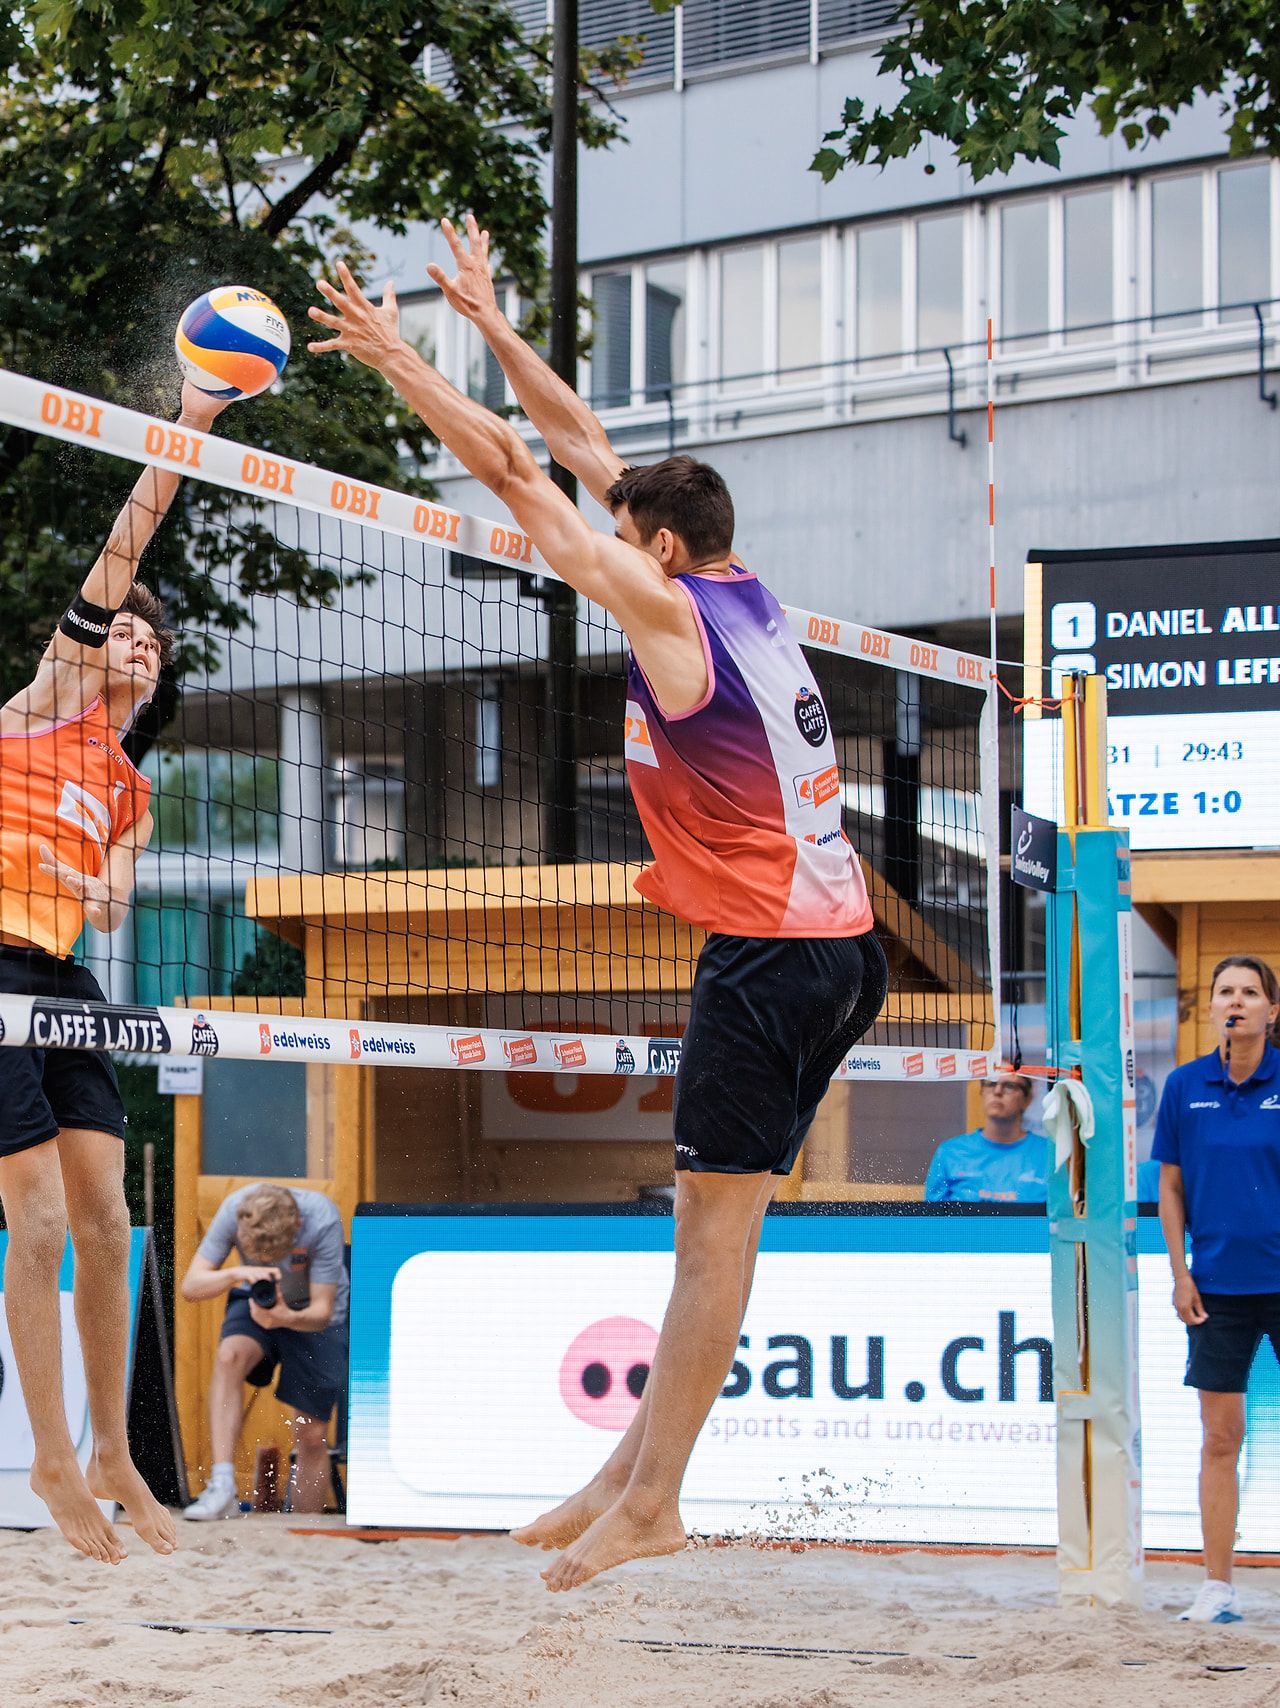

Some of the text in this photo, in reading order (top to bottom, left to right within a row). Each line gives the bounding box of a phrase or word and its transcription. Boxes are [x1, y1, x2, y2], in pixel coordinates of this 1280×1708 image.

[40, 392, 103, 438] OBI
[145, 423, 203, 468] OBI
[241, 453, 295, 494] OBI
[330, 480, 381, 519] OBI
[413, 504, 461, 542] OBI
[490, 527, 534, 563] OBI
[67, 608, 109, 635] CONCORDIA
[807, 616, 840, 646] OBI
[1067, 616, 1079, 638] 1
[1106, 605, 1280, 638] DANIEL ALL
[860, 631, 891, 658] OBI
[910, 644, 938, 671] OBI
[956, 656, 983, 682] OBI
[1106, 661, 1206, 690] SIMON
[799, 701, 823, 720] CAFFÈ
[803, 716, 825, 733] LATTE
[624, 716, 652, 747] BI
[99, 742, 124, 766] sau.ch
[1182, 741, 1243, 762] 29:43
[1193, 790, 1242, 814] 1:0
[33, 1004, 163, 1053] CAFFÈ LATTE
[193, 1025, 216, 1042] CAFFÈ
[273, 1032, 331, 1050] edelweiss
[362, 1038, 416, 1055] edelweiss
[650, 1040, 682, 1074] CAFF
[848, 1057, 881, 1071] edelweiss
[721, 1311, 1055, 1402] sau.ch
[709, 1414, 1058, 1443] sports and underwear
